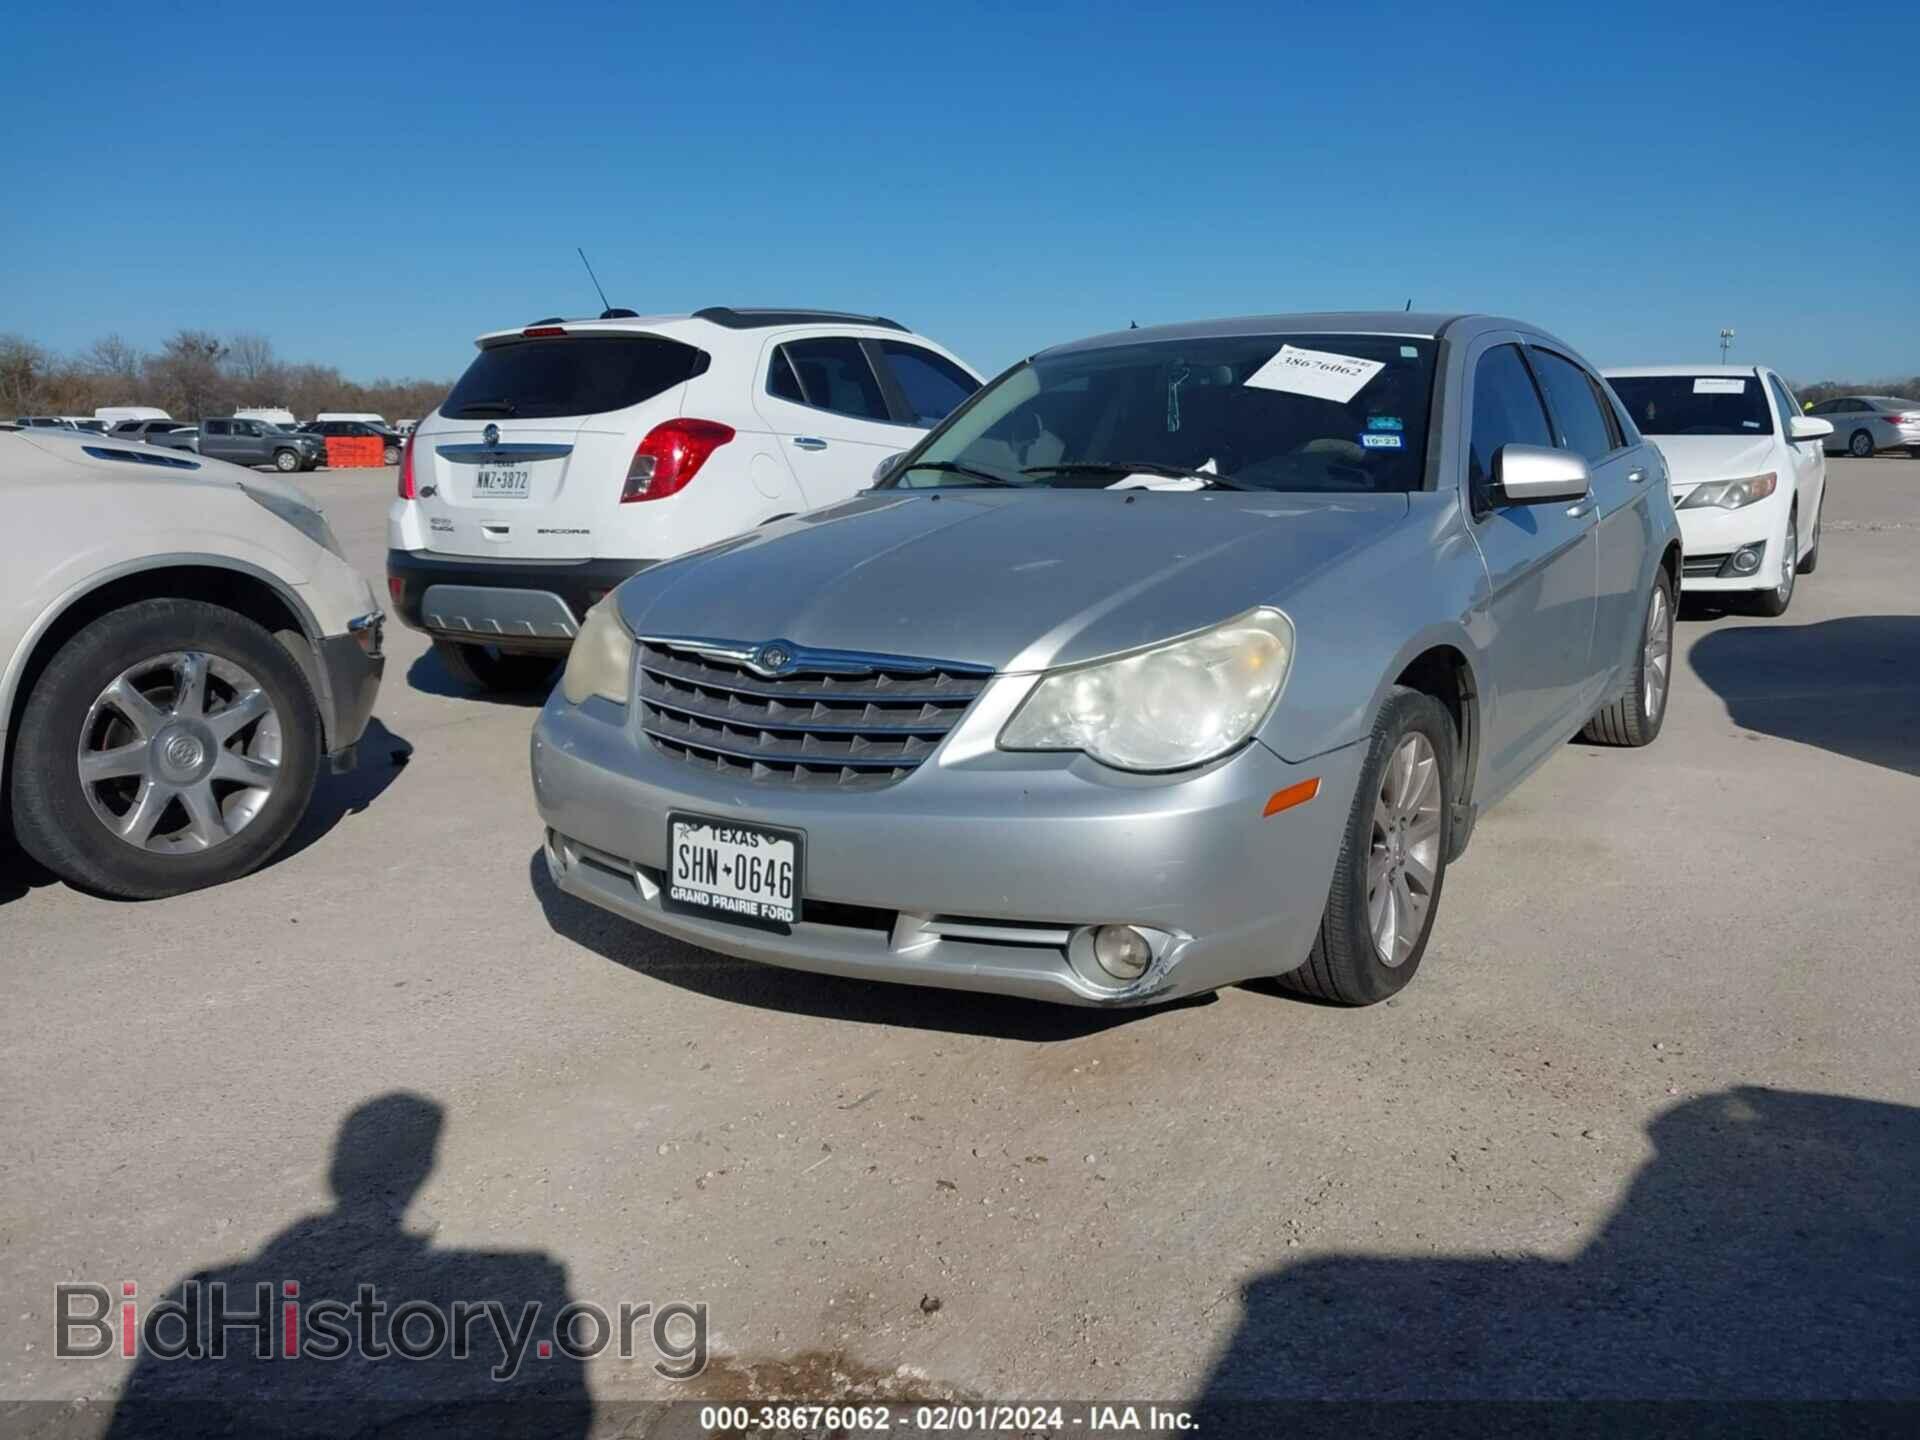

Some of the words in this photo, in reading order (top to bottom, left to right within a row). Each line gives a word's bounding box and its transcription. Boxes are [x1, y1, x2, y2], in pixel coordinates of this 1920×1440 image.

[710, 825, 760, 848] TEXAS
[671, 886, 709, 905] GRAND
[712, 894, 759, 916] PRAIRIE
[761, 904, 795, 923] FORD
